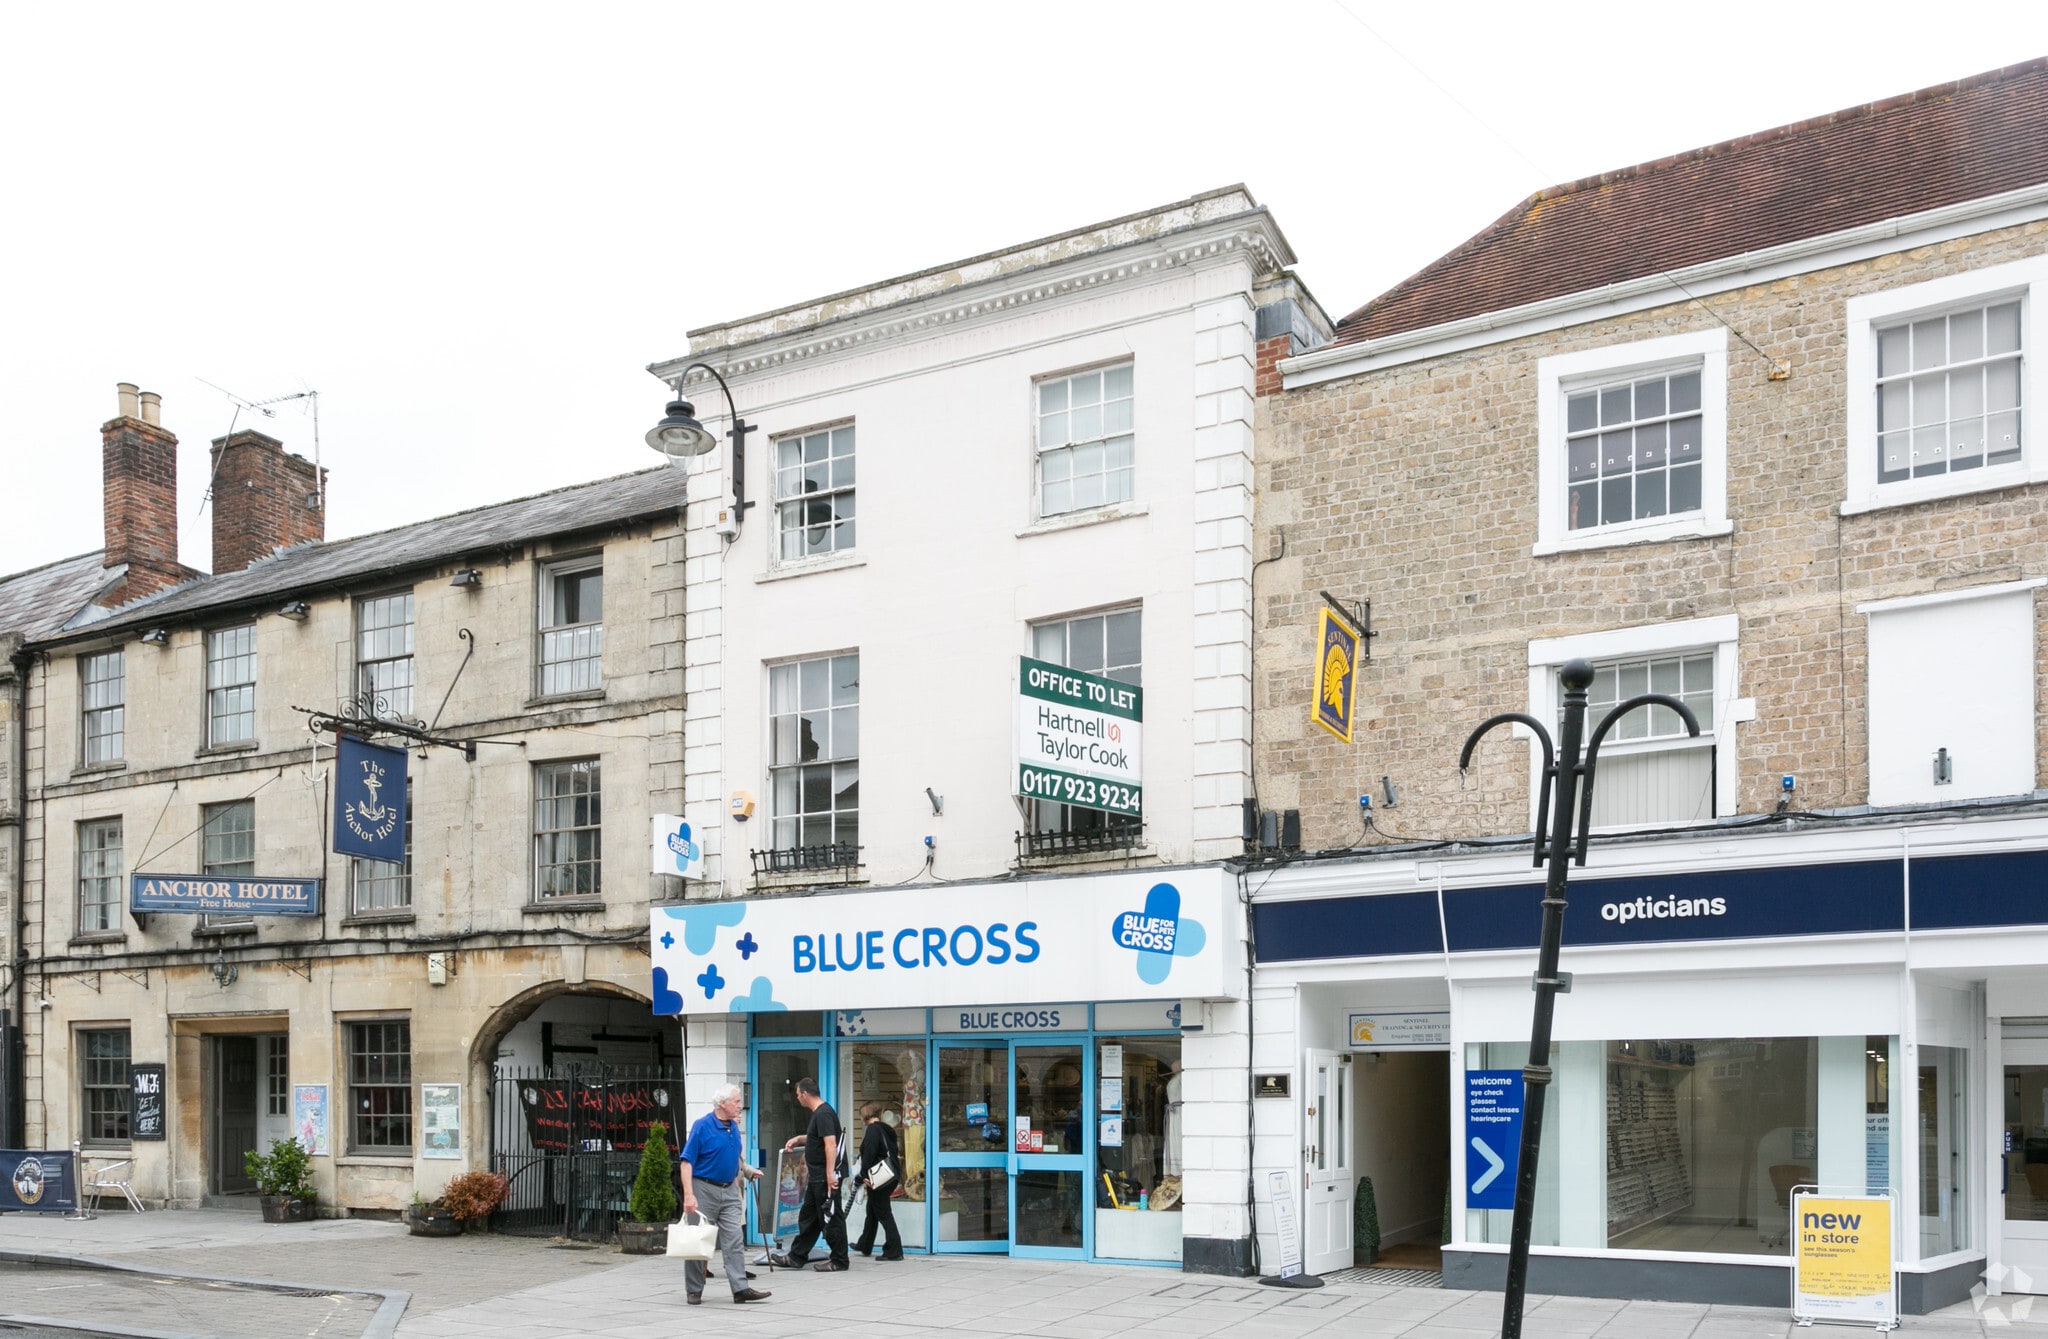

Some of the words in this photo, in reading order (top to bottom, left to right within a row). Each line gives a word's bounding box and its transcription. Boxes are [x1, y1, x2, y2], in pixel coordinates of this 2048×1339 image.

[1327, 630, 1352, 659] SENTINEL
[1028, 667, 1082, 697] OFFICE
[1086, 682, 1107, 702] TO
[1110, 688, 1136, 710] LET
[1038, 705, 1105, 739] Hartnell
[1037, 731, 1087, 761] Taylor
[1089, 743, 1128, 770] Cook
[360, 760, 386, 777] The
[1022, 769, 1062, 797] 0117
[1064, 777, 1096, 803] 923
[1099, 783, 1140, 812] 9234
[345, 801, 374, 842] Anchor
[376, 807, 397, 840] Hotel
[141, 880, 232, 898] ANCHOR
[237, 882, 308, 901] HOTEL
[200, 898, 220, 908] Free
[223, 899, 251, 909] House
[1601, 894, 1727, 924] opticians
[1123, 914, 1160, 934] BLUE
[1158, 926, 1176, 936] PETS
[1160, 919, 1175, 928] FOR
[793, 930, 885, 973] BLUE
[893, 921, 1041, 969] CROSS
[1120, 930, 1174, 951] CROSS
[960, 1012, 999, 1029] BLUE
[1001, 1010, 1060, 1028] CROSS
[1470, 1076, 1512, 1086] welcome
[1470, 1098, 1497, 1106] glasses
[1470, 1115, 1512, 1123] hearingcare
[1803, 1212, 1861, 1230] new
[1803, 1231, 1816, 1242] in
[1821, 1233, 1859, 1244] store
